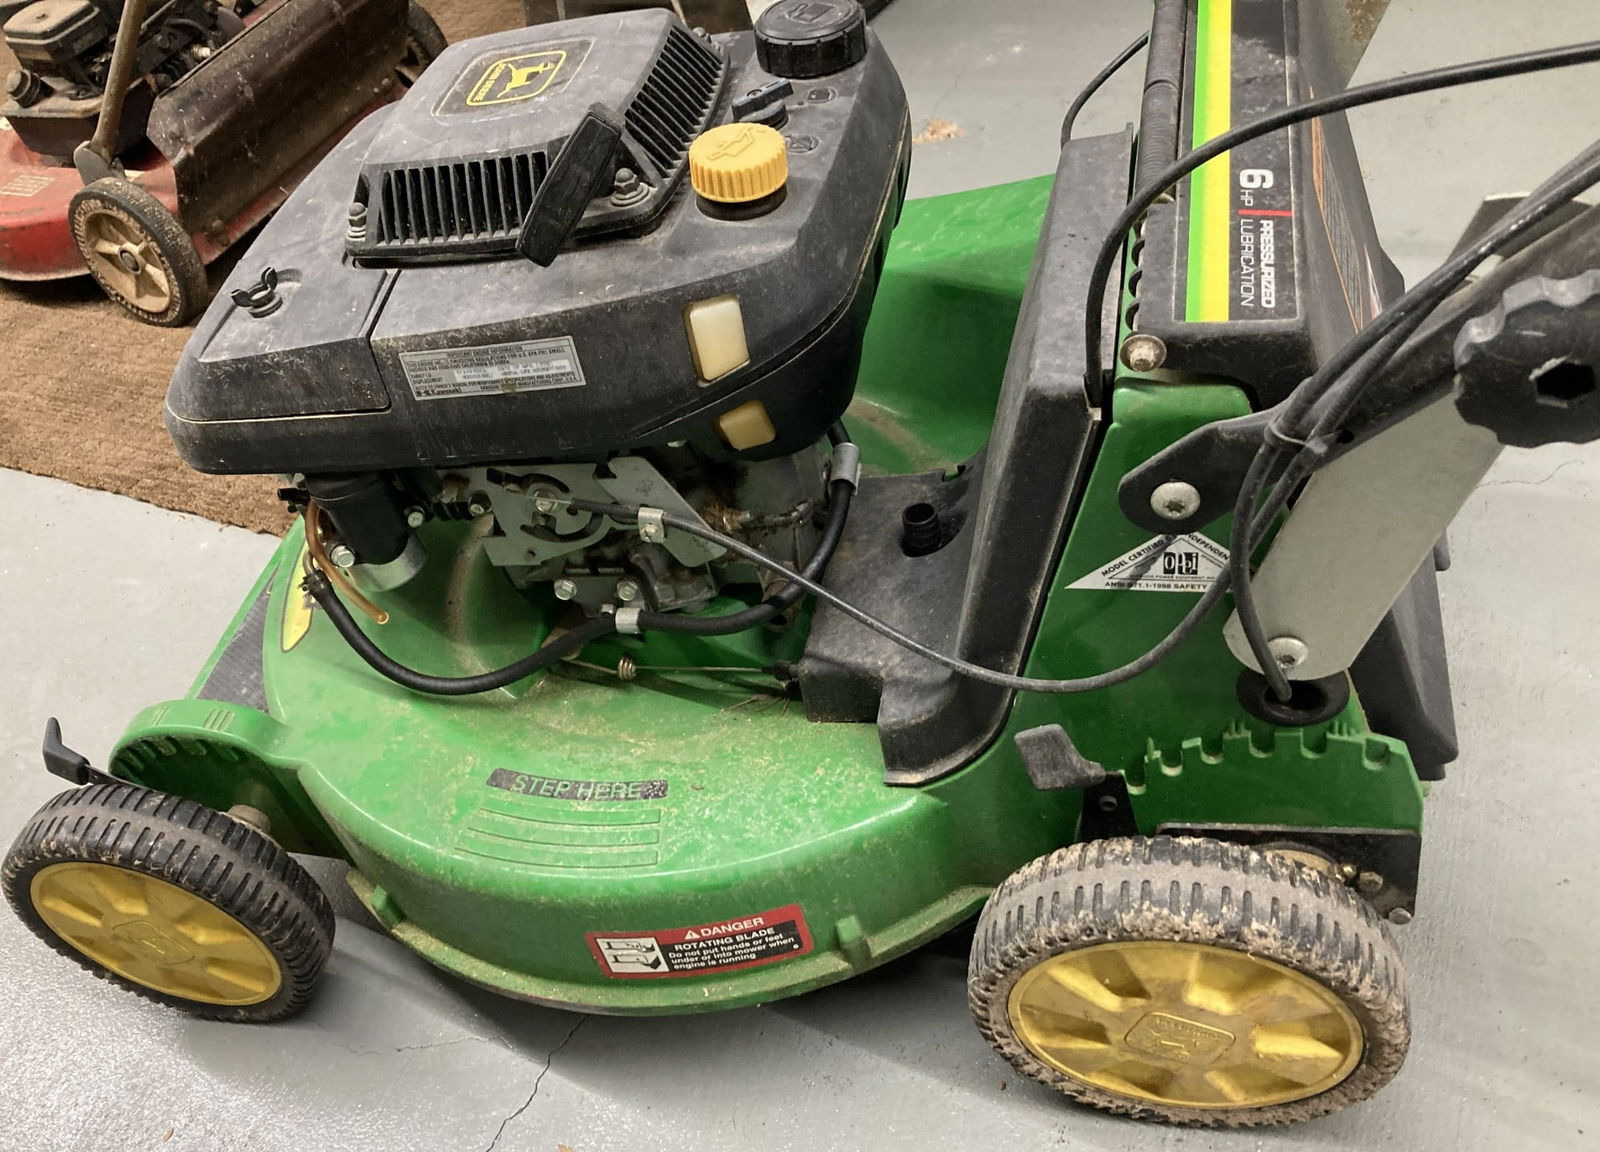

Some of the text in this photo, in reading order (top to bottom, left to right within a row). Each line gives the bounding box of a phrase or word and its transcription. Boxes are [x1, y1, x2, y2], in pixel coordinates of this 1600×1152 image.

[1239, 168, 1274, 207] 6 HP
[1239, 218, 1255, 307] LUBRICATION
[1259, 219, 1276, 309] PRESSURIZED
[1101, 559, 1129, 577] MODEL
[1128, 540, 1165, 562] CERTIFIED
[513, 774, 643, 801] STEP HERE
[675, 927, 776, 951] ROTATING BLADE
[701, 917, 765, 937] DANGER
[703, 948, 720, 956] put
[721, 942, 751, 952] hands
[765, 933, 784, 943] feet
[714, 951, 733, 959] into
[735, 944, 767, 956] mower
[769, 937, 795, 949] when
[674, 961, 706, 970] engine
[719, 953, 757, 964] running
